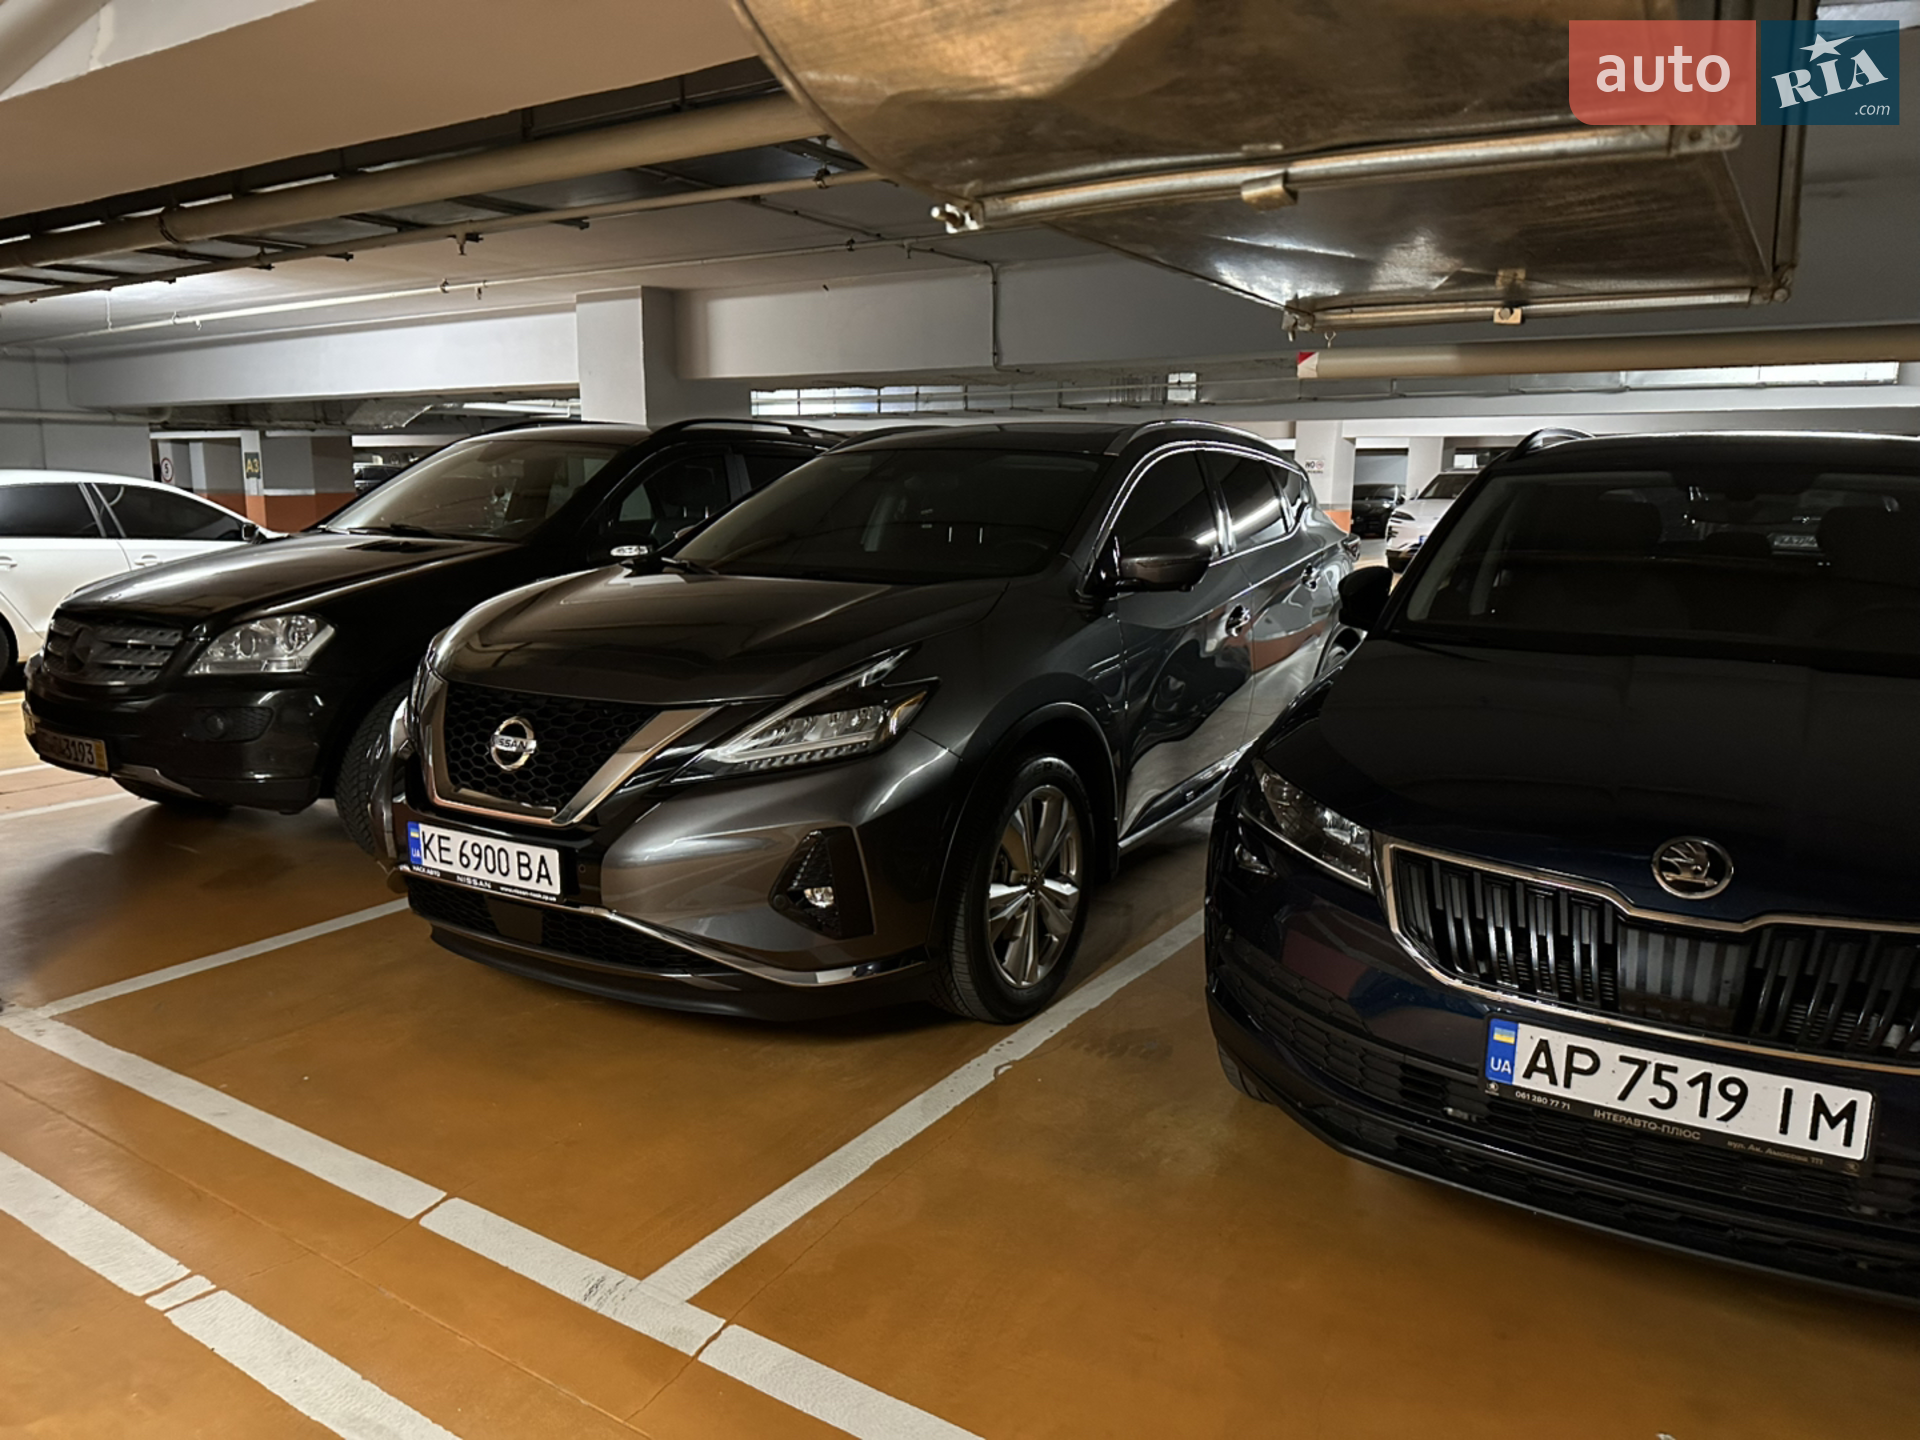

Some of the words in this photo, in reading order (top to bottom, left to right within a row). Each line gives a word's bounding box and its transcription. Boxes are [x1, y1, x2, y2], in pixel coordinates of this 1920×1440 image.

[246, 458, 260, 473] A3
[411, 847, 422, 858] UA
[421, 831, 454, 866] KE
[459, 840, 511, 877] 6900
[516, 850, 554, 887] BA
[456, 875, 492, 889] NISSAN
[1490, 1056, 1512, 1075] UA
[1515, 1091, 1531, 1101] 061
[1532, 1094, 1548, 1105] 280
[1550, 1099, 1560, 1107] 77
[1561, 1102, 1571, 1110] 71
[1522, 1038, 1601, 1089] AP
[1617, 1054, 1749, 1122] 7519
[1778, 1087, 1858, 1148] IM
